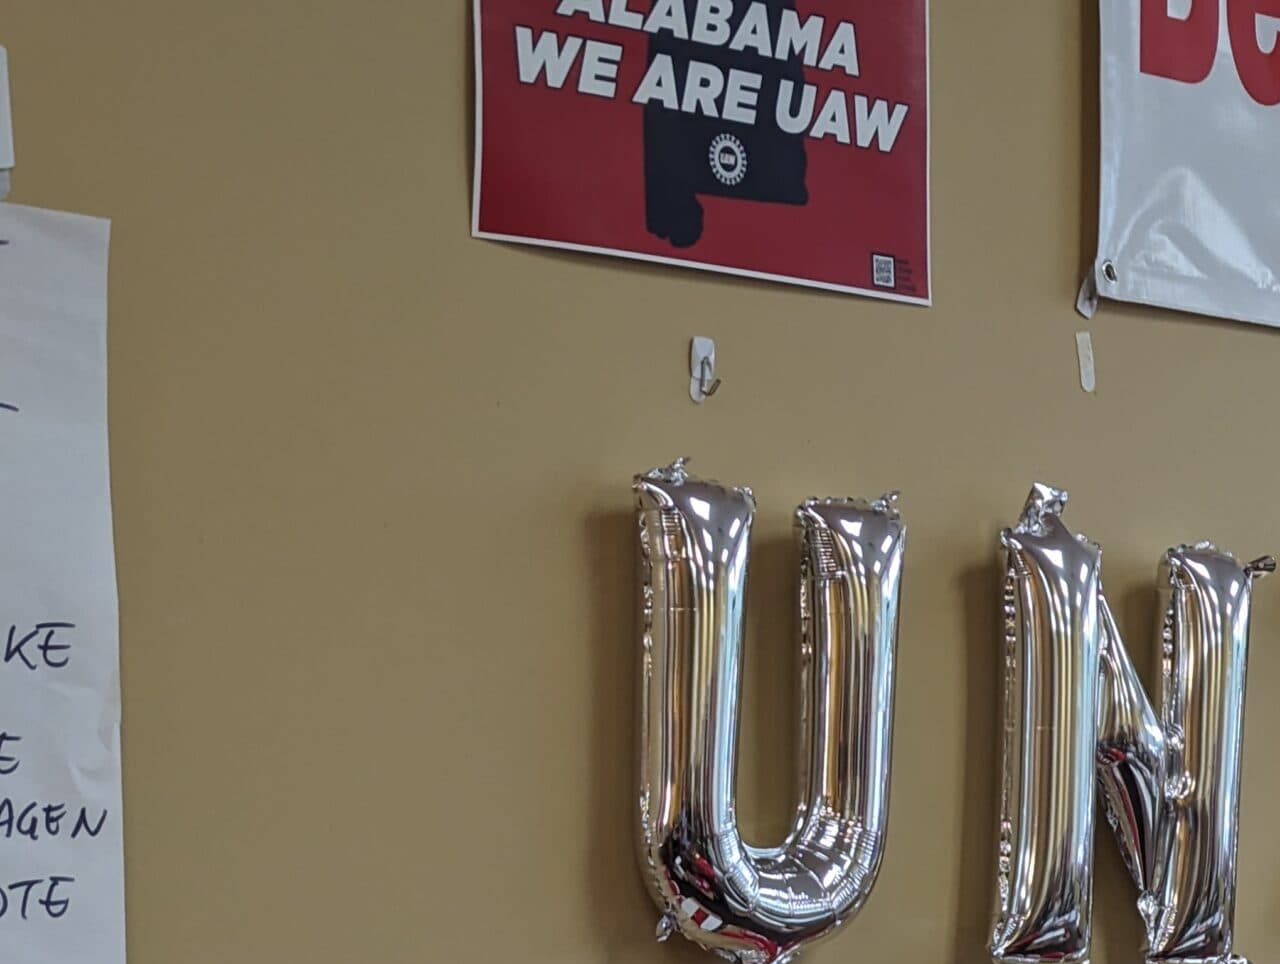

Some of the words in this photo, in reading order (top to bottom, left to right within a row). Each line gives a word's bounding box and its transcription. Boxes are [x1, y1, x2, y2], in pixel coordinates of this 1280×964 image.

[515, 27, 624, 98] WE
[632, 55, 763, 125] ARE
[775, 79, 909, 153] UAW
